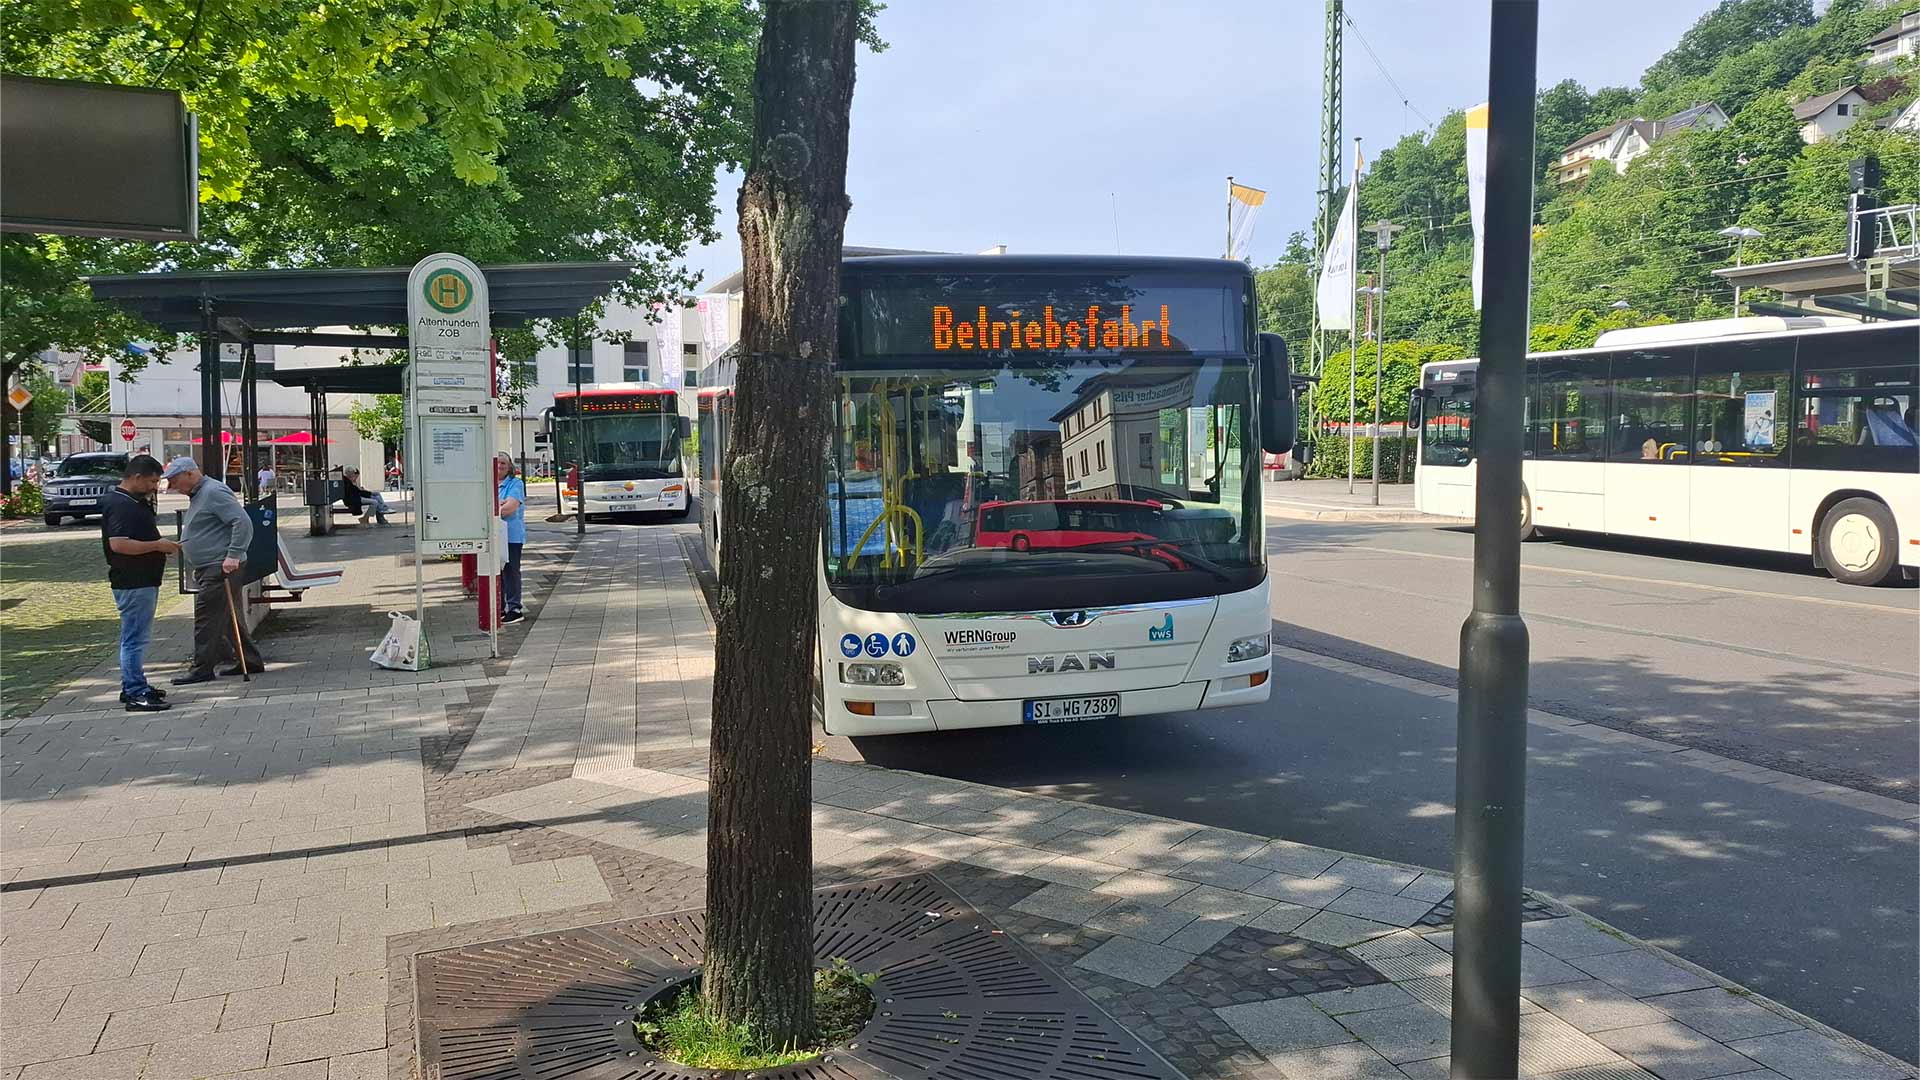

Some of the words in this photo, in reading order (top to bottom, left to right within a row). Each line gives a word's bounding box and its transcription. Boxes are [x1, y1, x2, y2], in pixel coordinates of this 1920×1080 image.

[439, 278, 459, 304] H
[418, 317, 480, 328] Altenhundem
[932, 304, 1172, 349] Betriebsfahrt
[438, 329, 460, 338] ZOB
[121, 426, 136, 435] STOP
[944, 629, 1017, 643] WERNGroup
[1151, 630, 1172, 639] VWS
[1027, 651, 1115, 674] MAN
[1034, 702, 1051, 718] SI
[1063, 700, 1080, 716] WG
[1084, 698, 1117, 715] 7389
